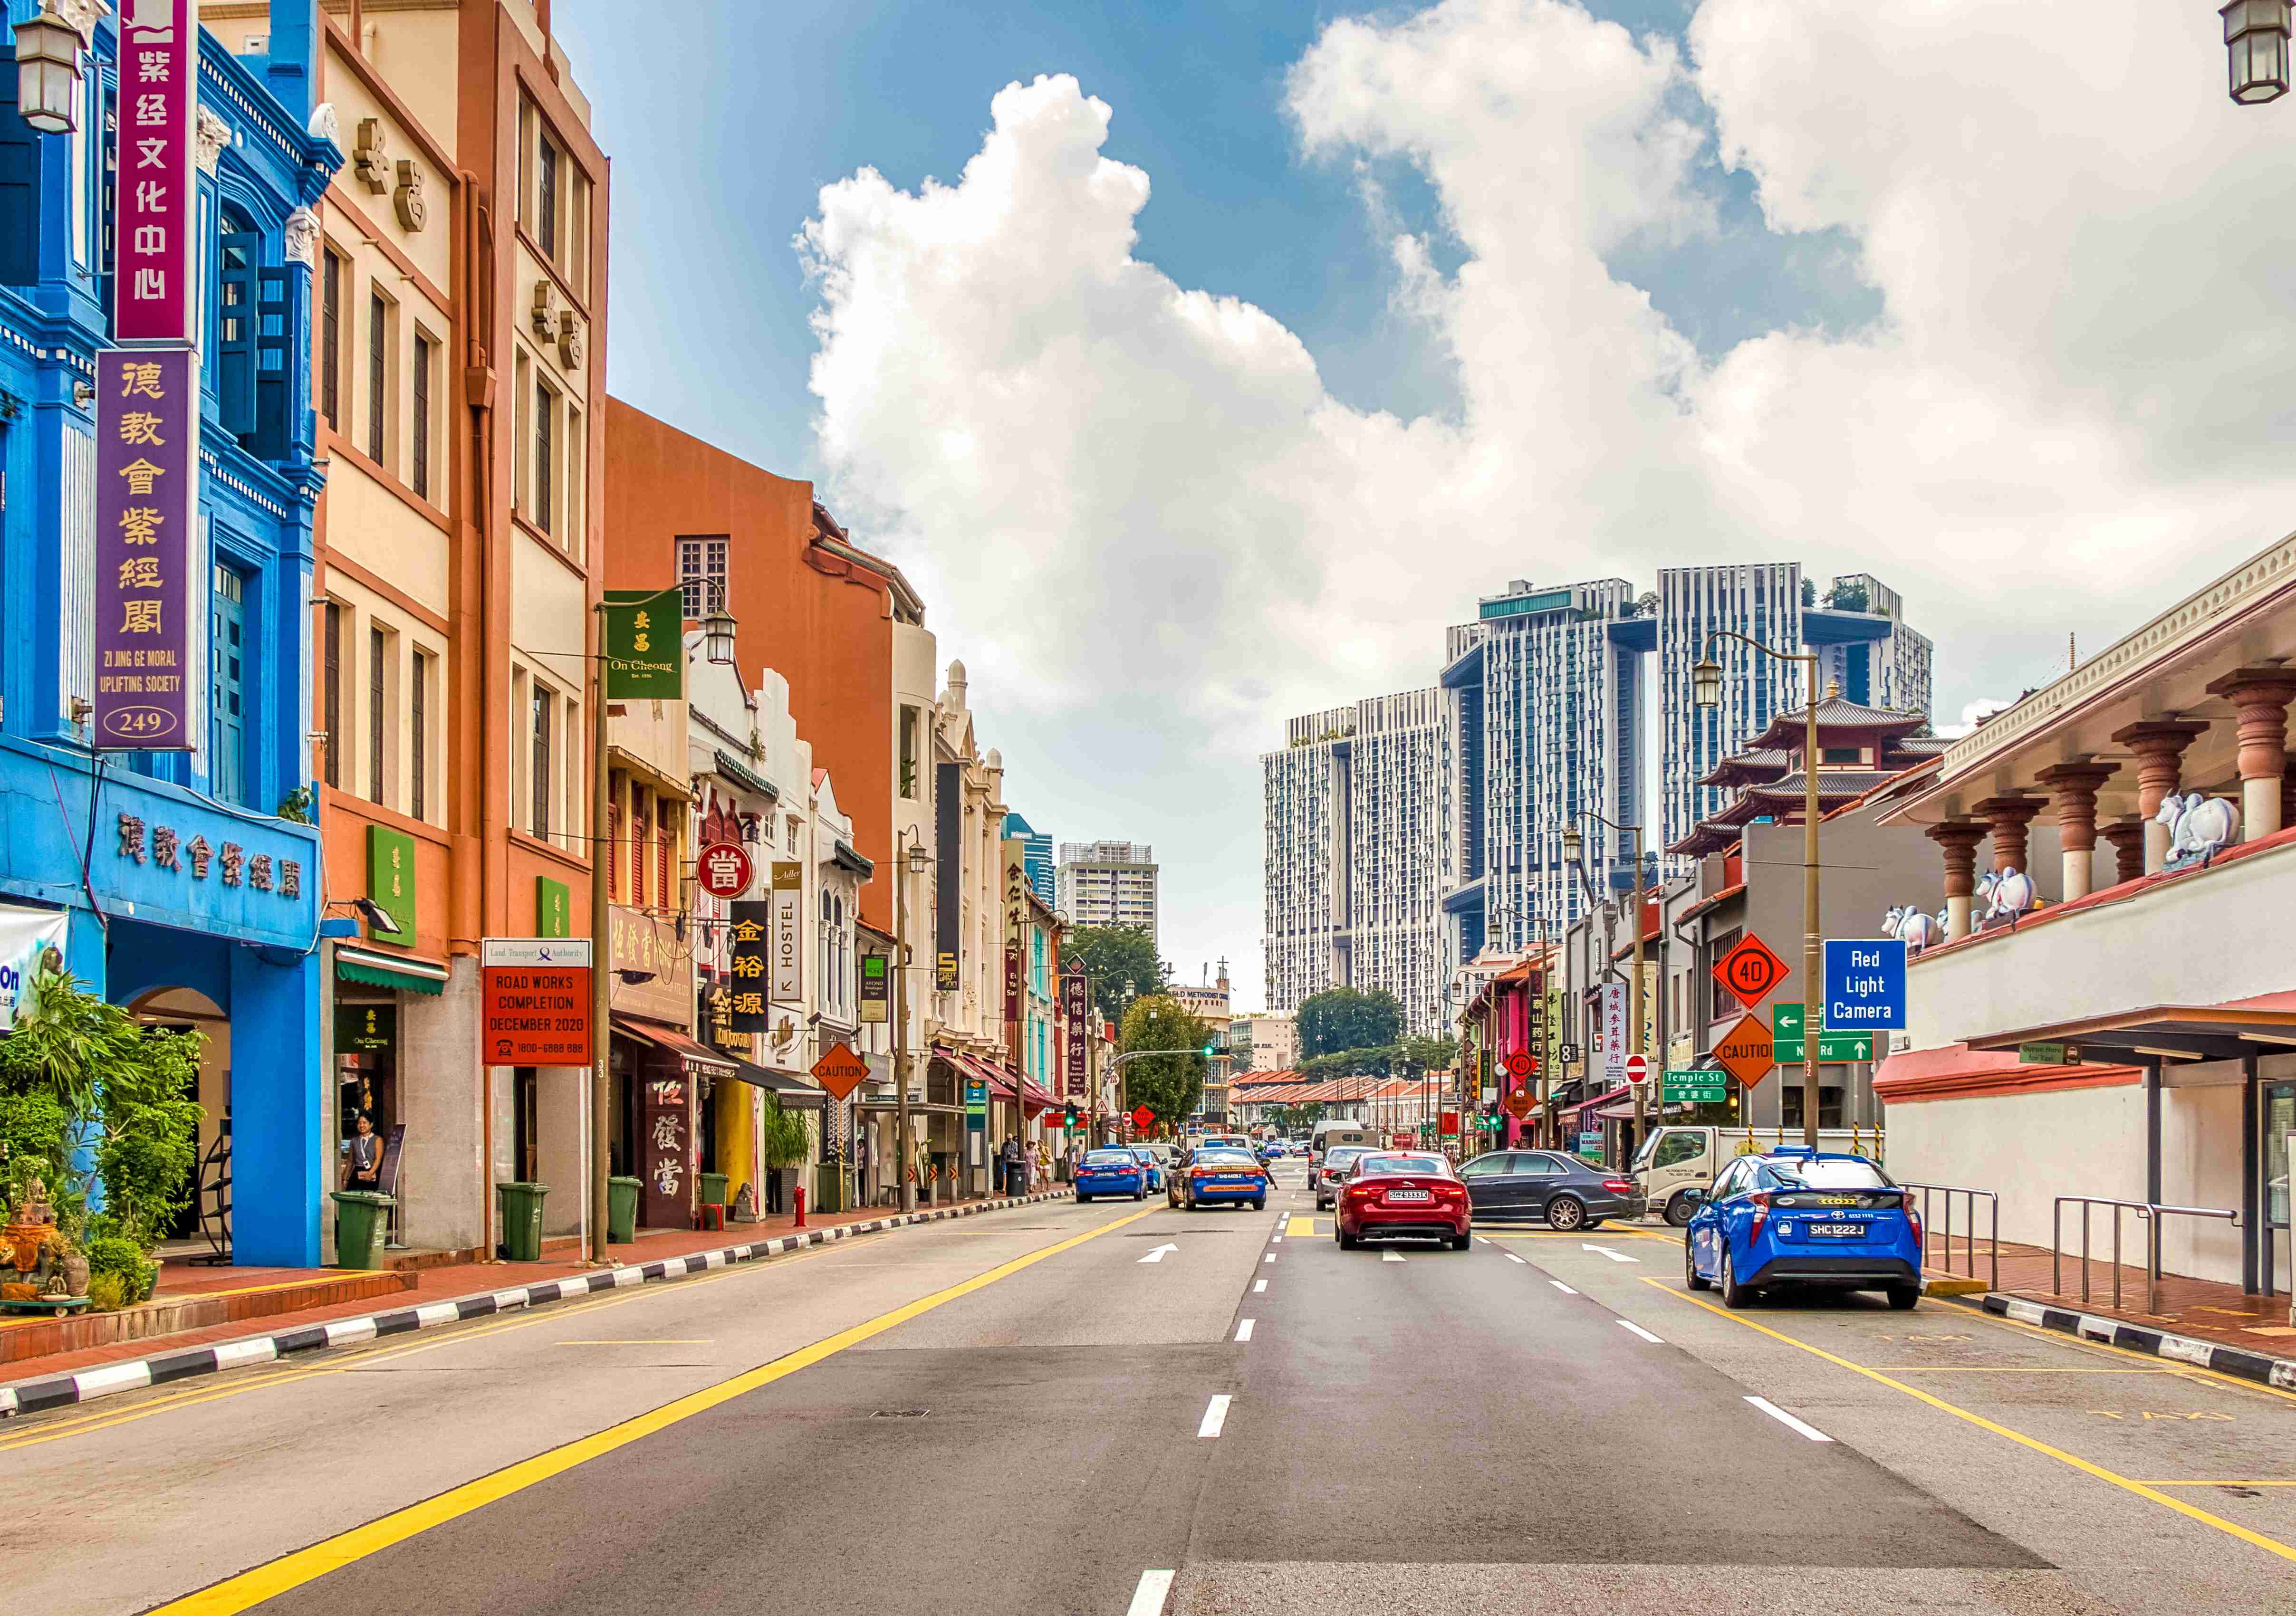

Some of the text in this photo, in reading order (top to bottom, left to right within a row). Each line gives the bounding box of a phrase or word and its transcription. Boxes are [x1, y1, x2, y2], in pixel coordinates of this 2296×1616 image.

[134, 51, 171, 300] 紫经文化中心
[119, 362, 166, 635] 德教會紫經閣
[634, 611, 650, 651] 安昌
[104, 650, 177, 667] ZI JING GE MORAL
[611, 660, 672, 673] On Cheong
[99, 676, 180, 692] UPLIFTING SOCIETY
[119, 713, 161, 731] 249
[707, 850, 741, 889] 當
[774, 869, 801, 881] Adler
[781, 901, 793, 968] HOSTEL
[490, 947, 583, 959] Land Transport Authority
[1852, 950, 1879, 968] Red
[732, 919, 765, 1014] 金裕源
[938, 953, 957, 972] 5
[1739, 961, 1762, 982] 40
[496, 975, 573, 989] ROAD WORKS
[1846, 976, 1885, 998] Light
[499, 996, 574, 1010] COMPLETION
[1834, 1002, 1892, 1020] Camera
[490, 1018, 584, 1031] DECEMBER 2020
[1723, 1044, 1773, 1059] CAUTIO
[1820, 1045, 1833, 1056] Rd
[818, 1066, 862, 1077] CAUTION
[1516, 1060, 1526, 1069] 40
[1667, 1073, 1720, 1083] Temple St
[1810, 1224, 1864, 1235] SHC1222J
